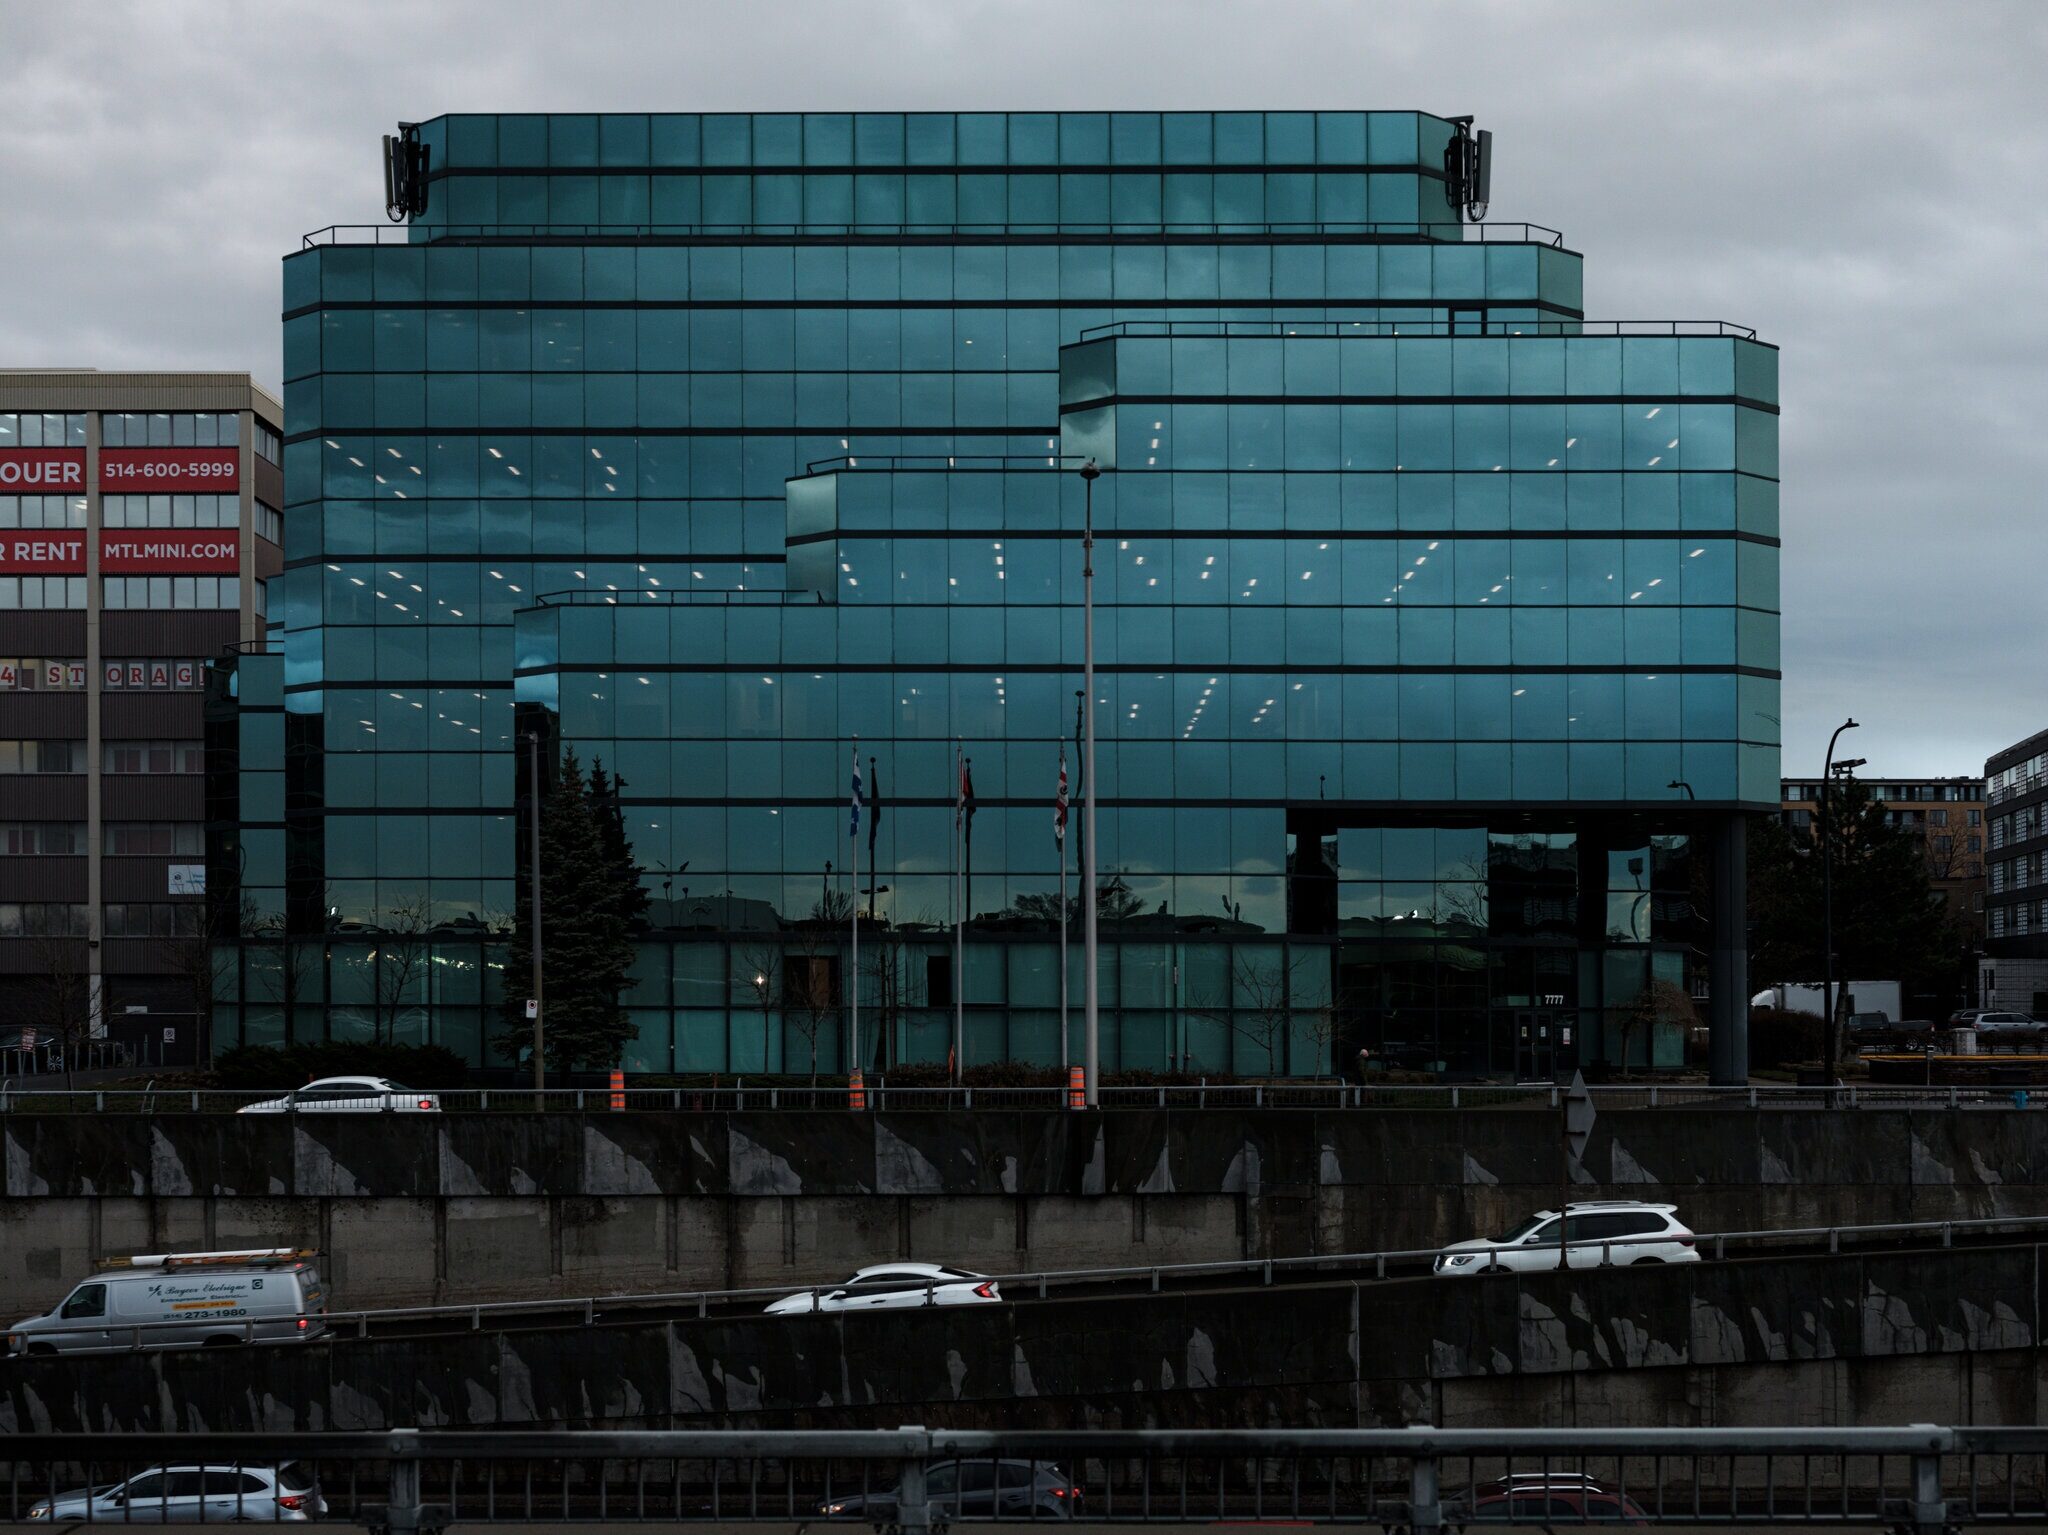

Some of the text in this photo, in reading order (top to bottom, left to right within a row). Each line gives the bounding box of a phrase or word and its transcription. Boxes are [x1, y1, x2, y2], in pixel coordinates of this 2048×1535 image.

[0, 461, 81, 483] OUER
[105, 463, 235, 477] 514-600-5999
[14, 542, 82, 561] RENT
[105, 544, 235, 558] MTLMINI.COM
[49, 666, 205, 684] STORAG
[1544, 994, 1564, 1005] 7777
[184, 1308, 247, 1319] 273-1980
